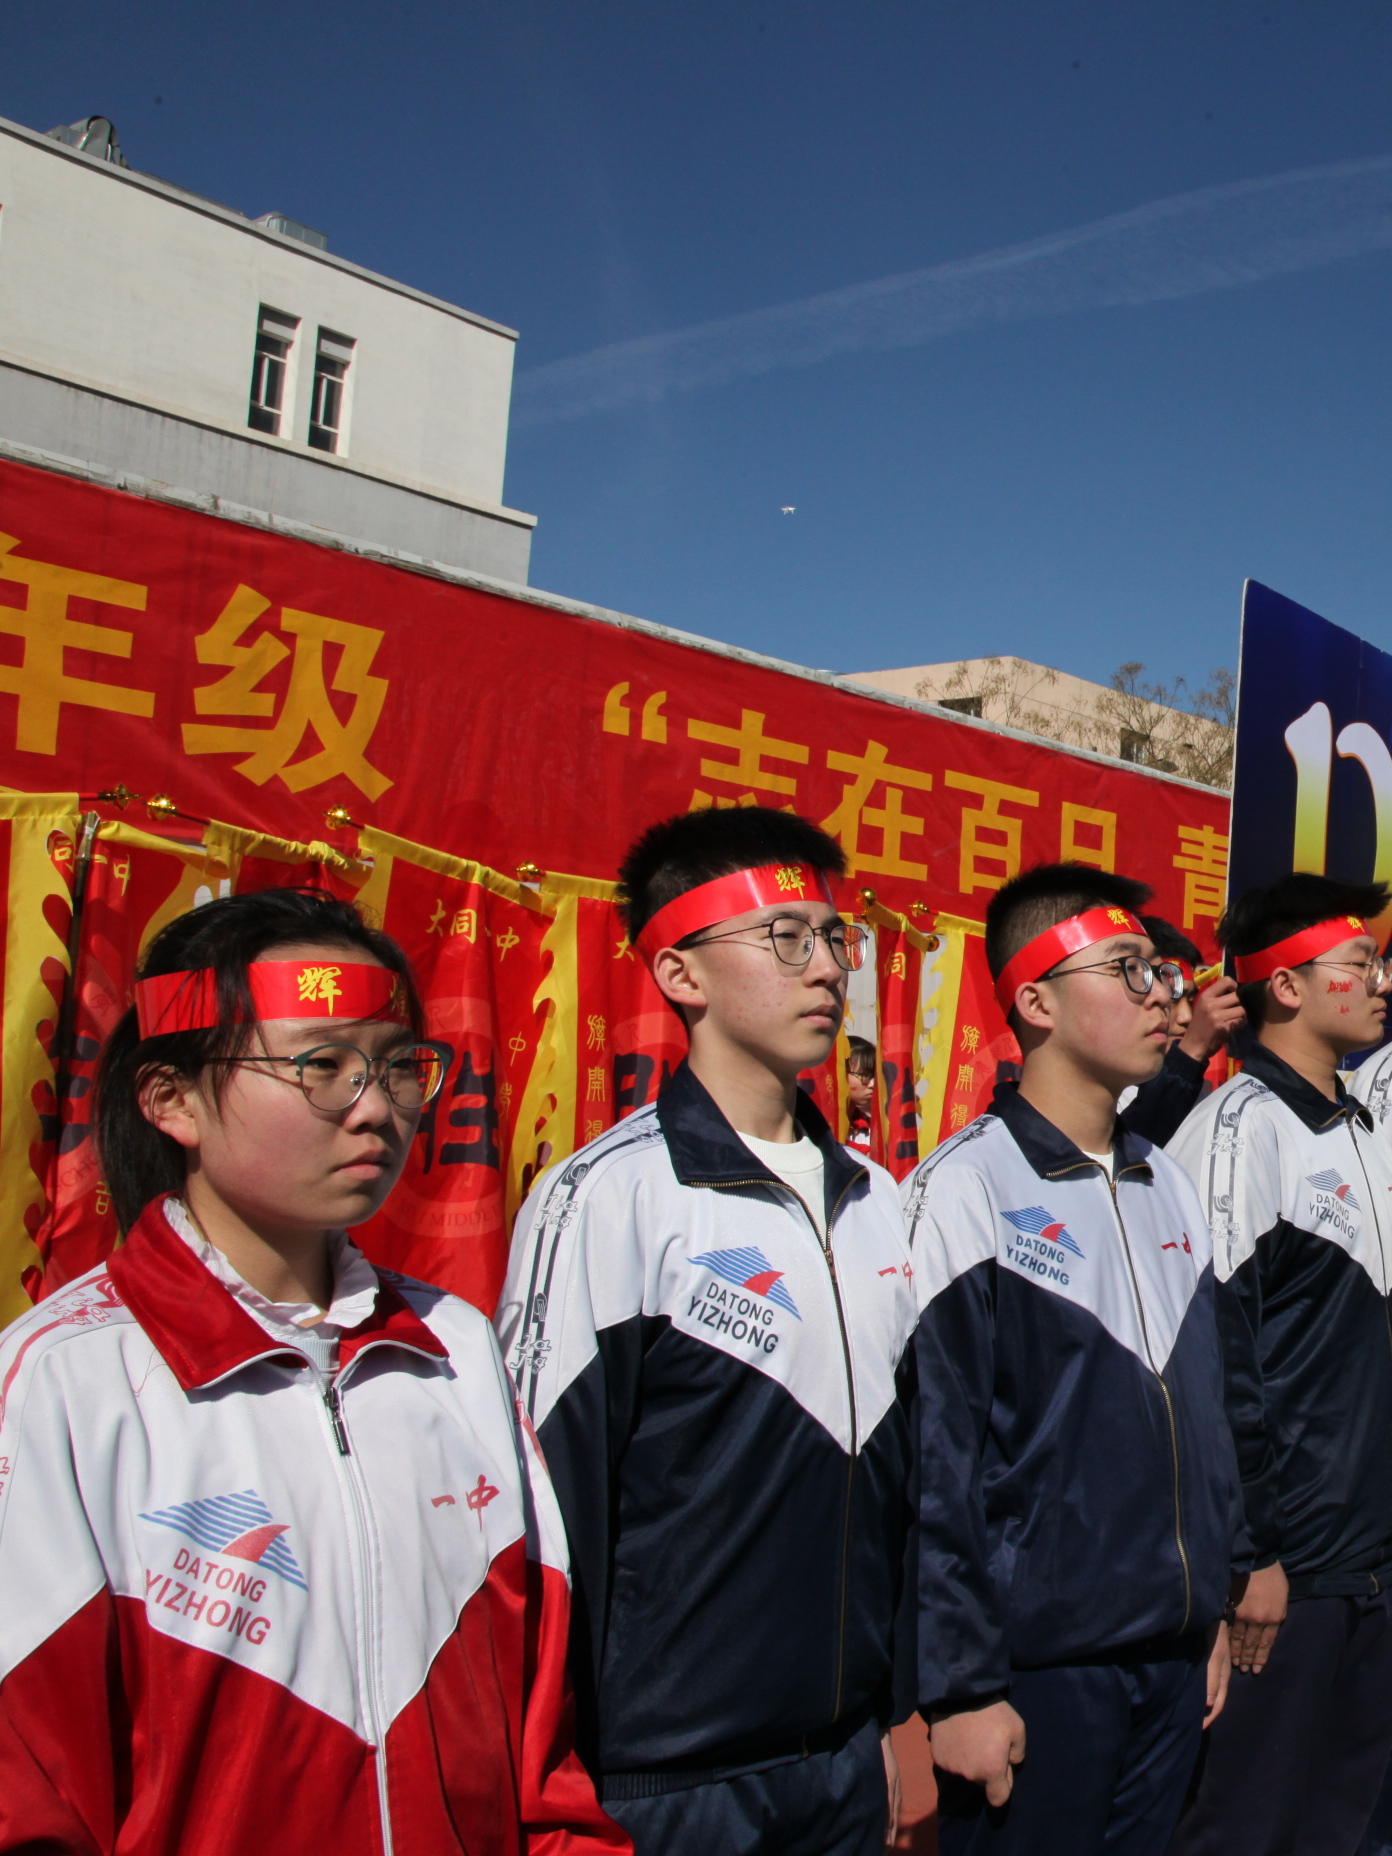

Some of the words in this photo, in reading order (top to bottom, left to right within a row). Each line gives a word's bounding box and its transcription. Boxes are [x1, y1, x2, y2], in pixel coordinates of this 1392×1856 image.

[774, 866, 806, 900] 辉
[296, 966, 343, 1017] 辉
[1309, 1202, 1356, 1240] YIZHONG
[1316, 1193, 1350, 1221] DATONG
[1006, 1244, 1070, 1287] YIZHONG
[1016, 1234, 1066, 1265] DATONG
[687, 1294, 780, 1355] YIZHONG
[706, 1281, 775, 1327] DATONG
[430, 1473, 501, 1533] 一中
[172, 1547, 268, 1604] DATONG
[144, 1568, 272, 1646] YIZHONG
